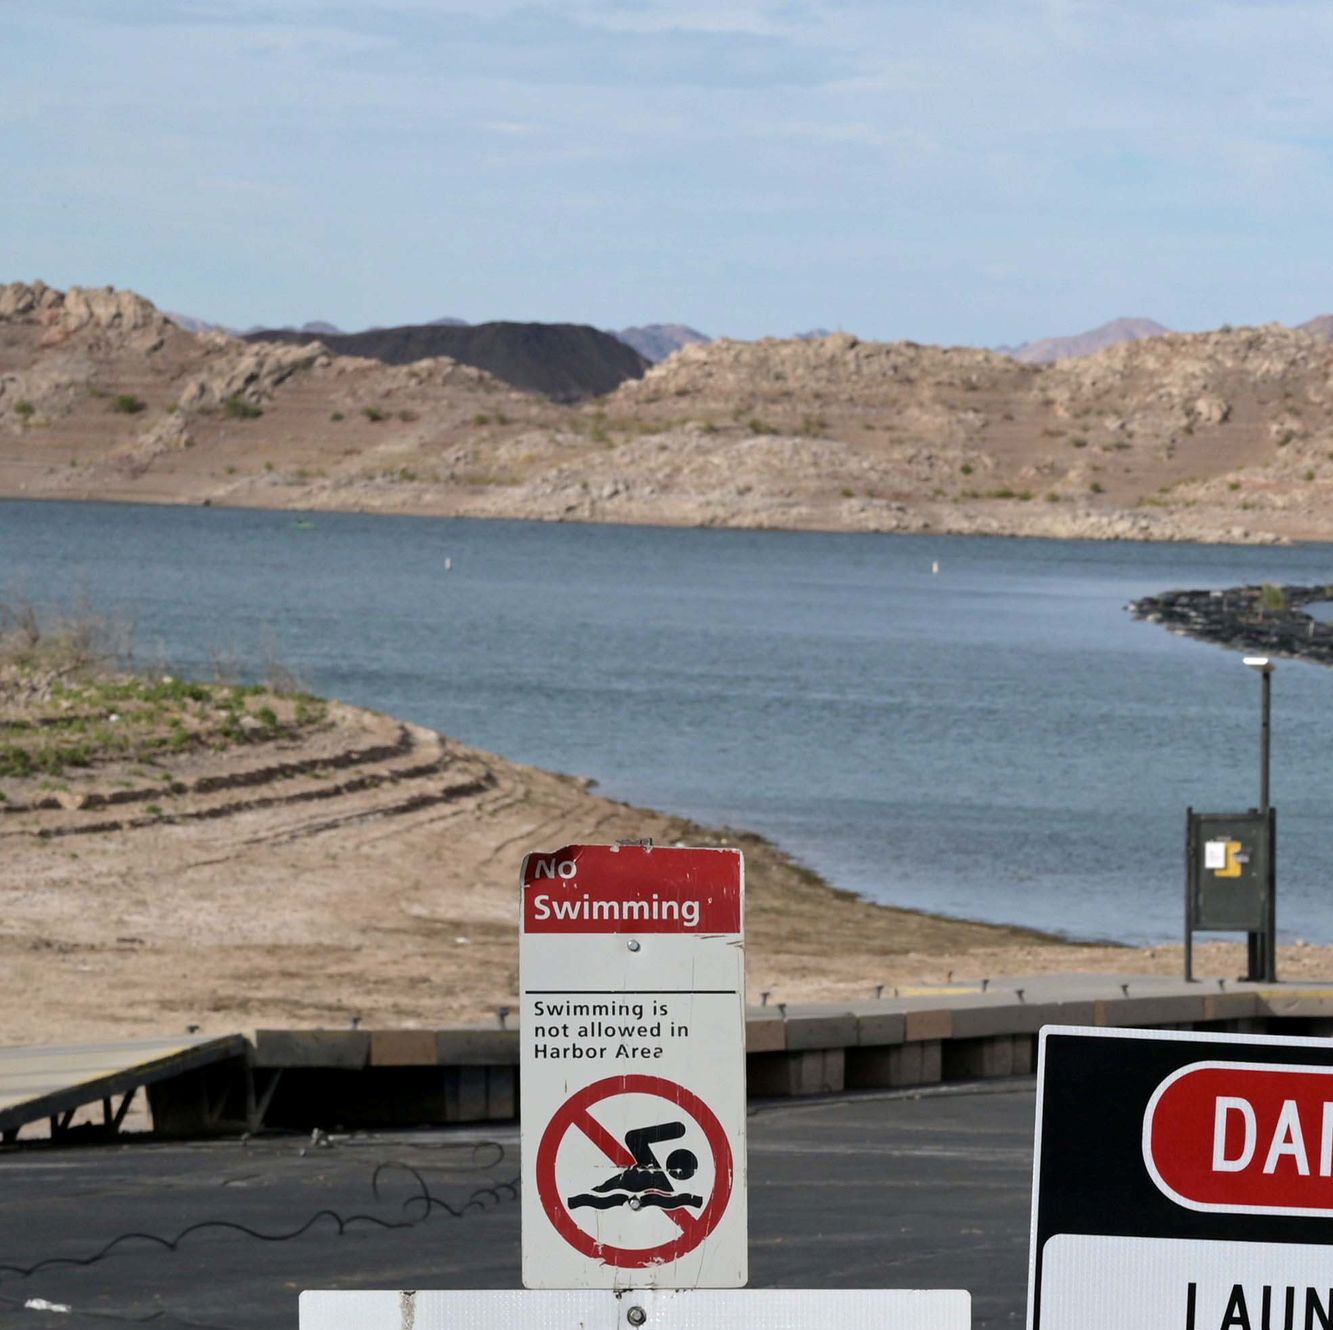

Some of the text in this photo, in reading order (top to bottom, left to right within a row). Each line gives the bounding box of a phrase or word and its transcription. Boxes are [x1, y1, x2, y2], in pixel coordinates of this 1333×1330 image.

[534, 859, 577, 880] No
[534, 894, 699, 927] Swimming
[534, 1000, 668, 1020] Swimming is
[534, 1021, 689, 1038] not allowed in
[534, 1043, 607, 1059] Harbor
